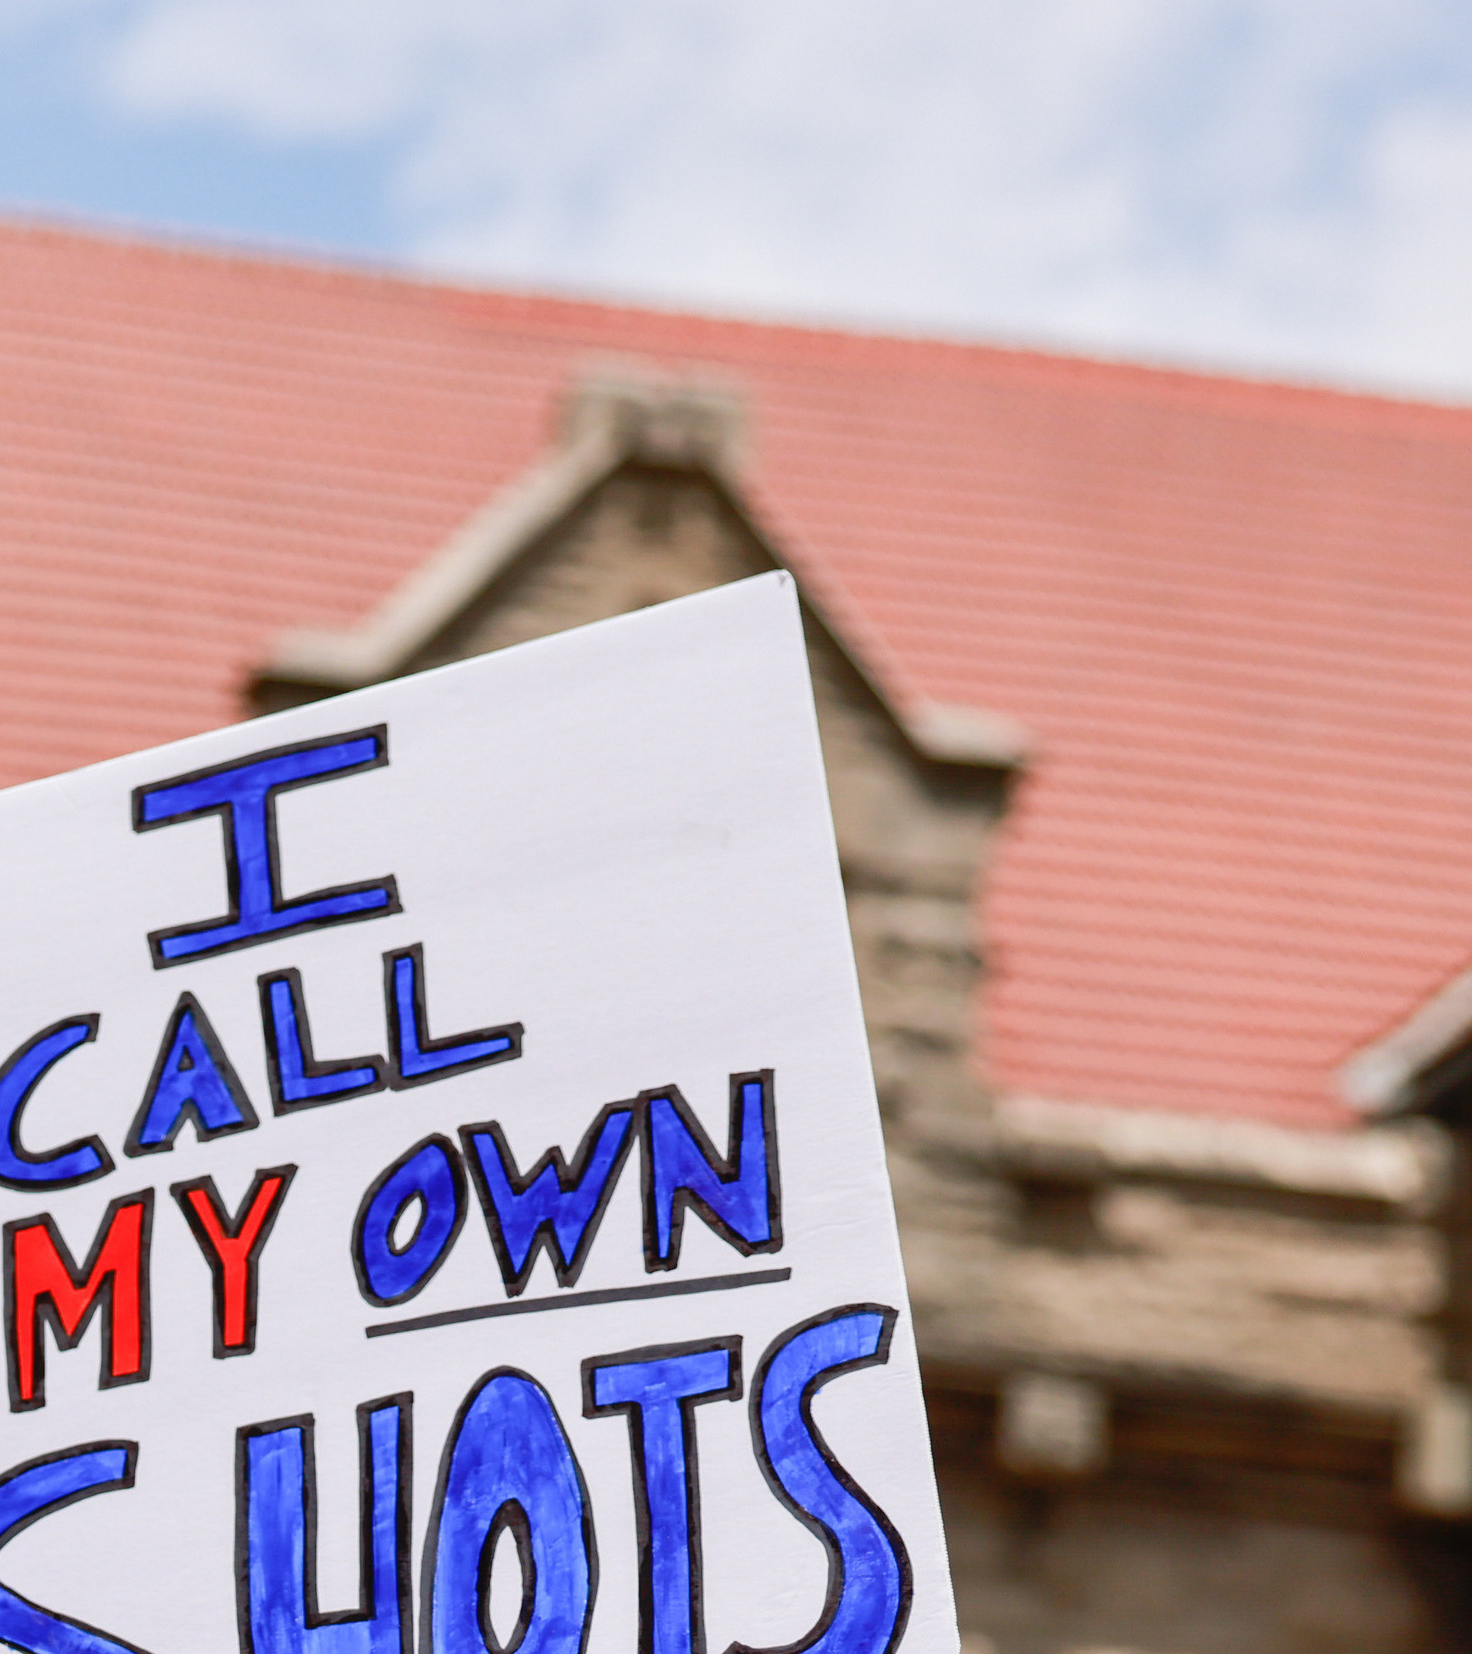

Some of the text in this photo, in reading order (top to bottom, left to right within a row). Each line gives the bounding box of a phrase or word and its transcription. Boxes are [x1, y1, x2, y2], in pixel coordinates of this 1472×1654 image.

[132, 724, 400, 968] I
[2, 1068, 784, 1414] MY OWN
